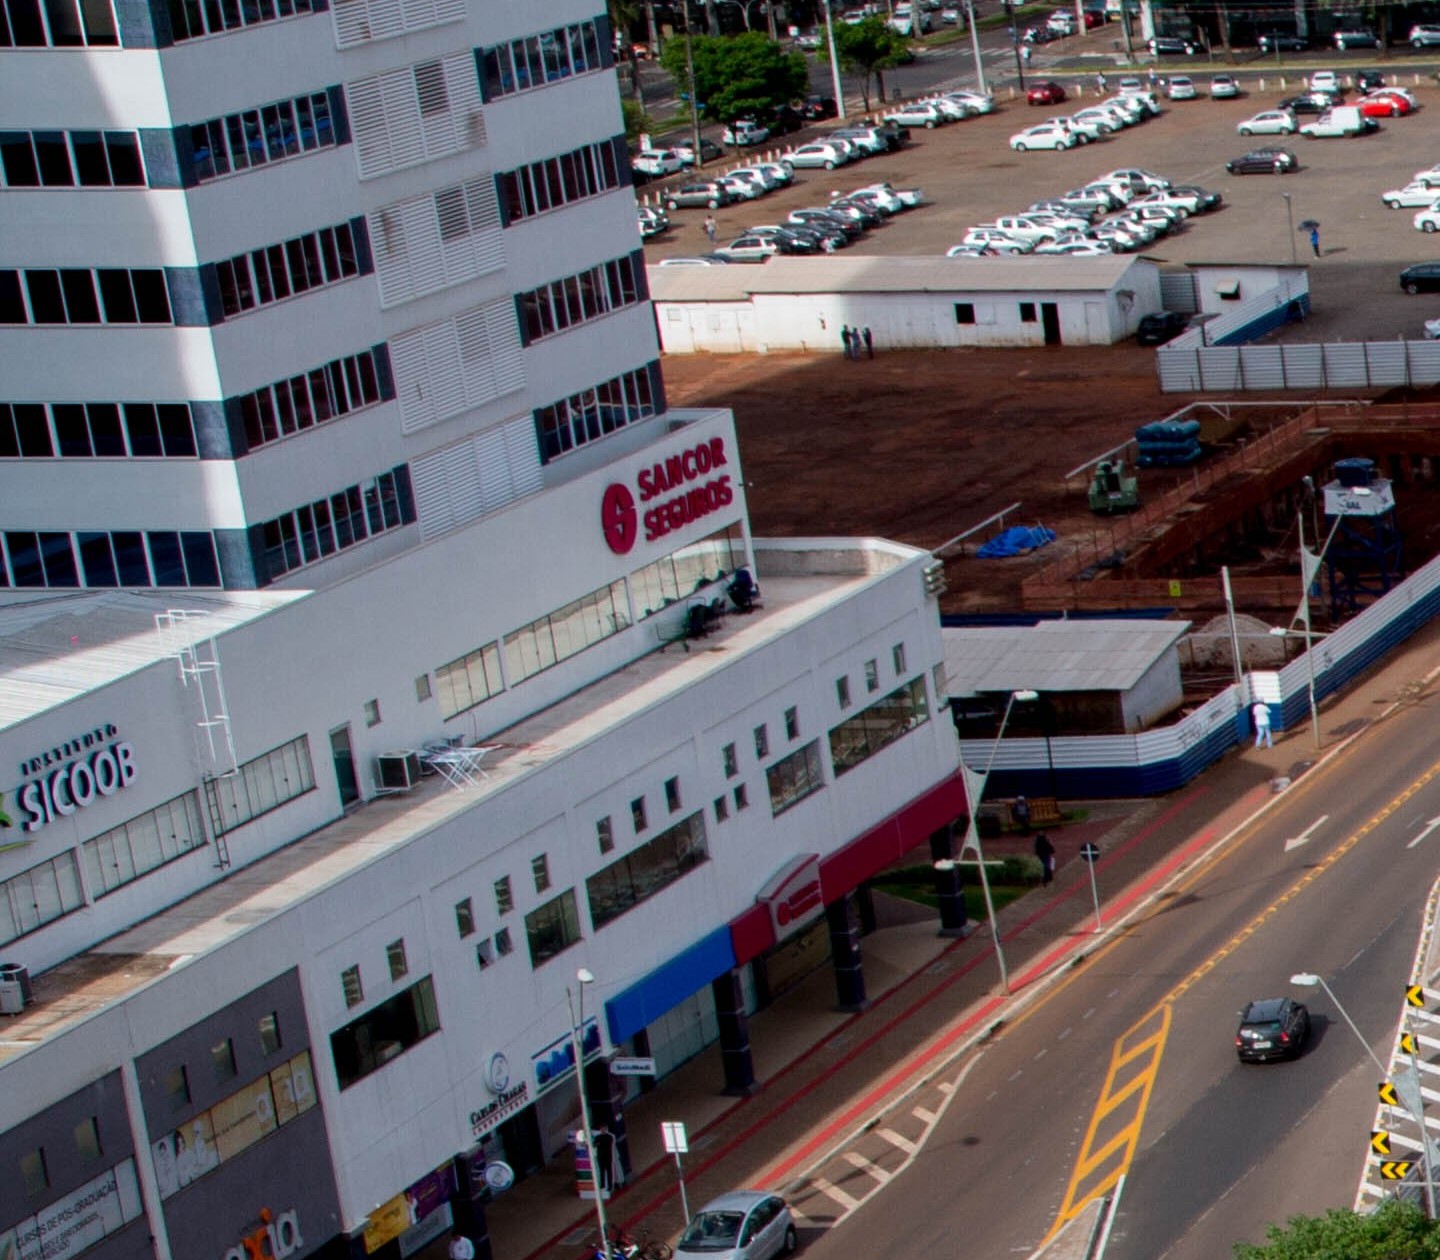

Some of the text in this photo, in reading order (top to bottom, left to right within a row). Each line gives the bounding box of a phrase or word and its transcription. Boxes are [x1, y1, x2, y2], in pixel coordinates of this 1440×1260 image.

[638, 437, 727, 501] SANCOR
[644, 475, 733, 541] SEGUROS
[21, 724, 117, 775] INSTITUTO
[17, 741, 138, 832] SICOOB
